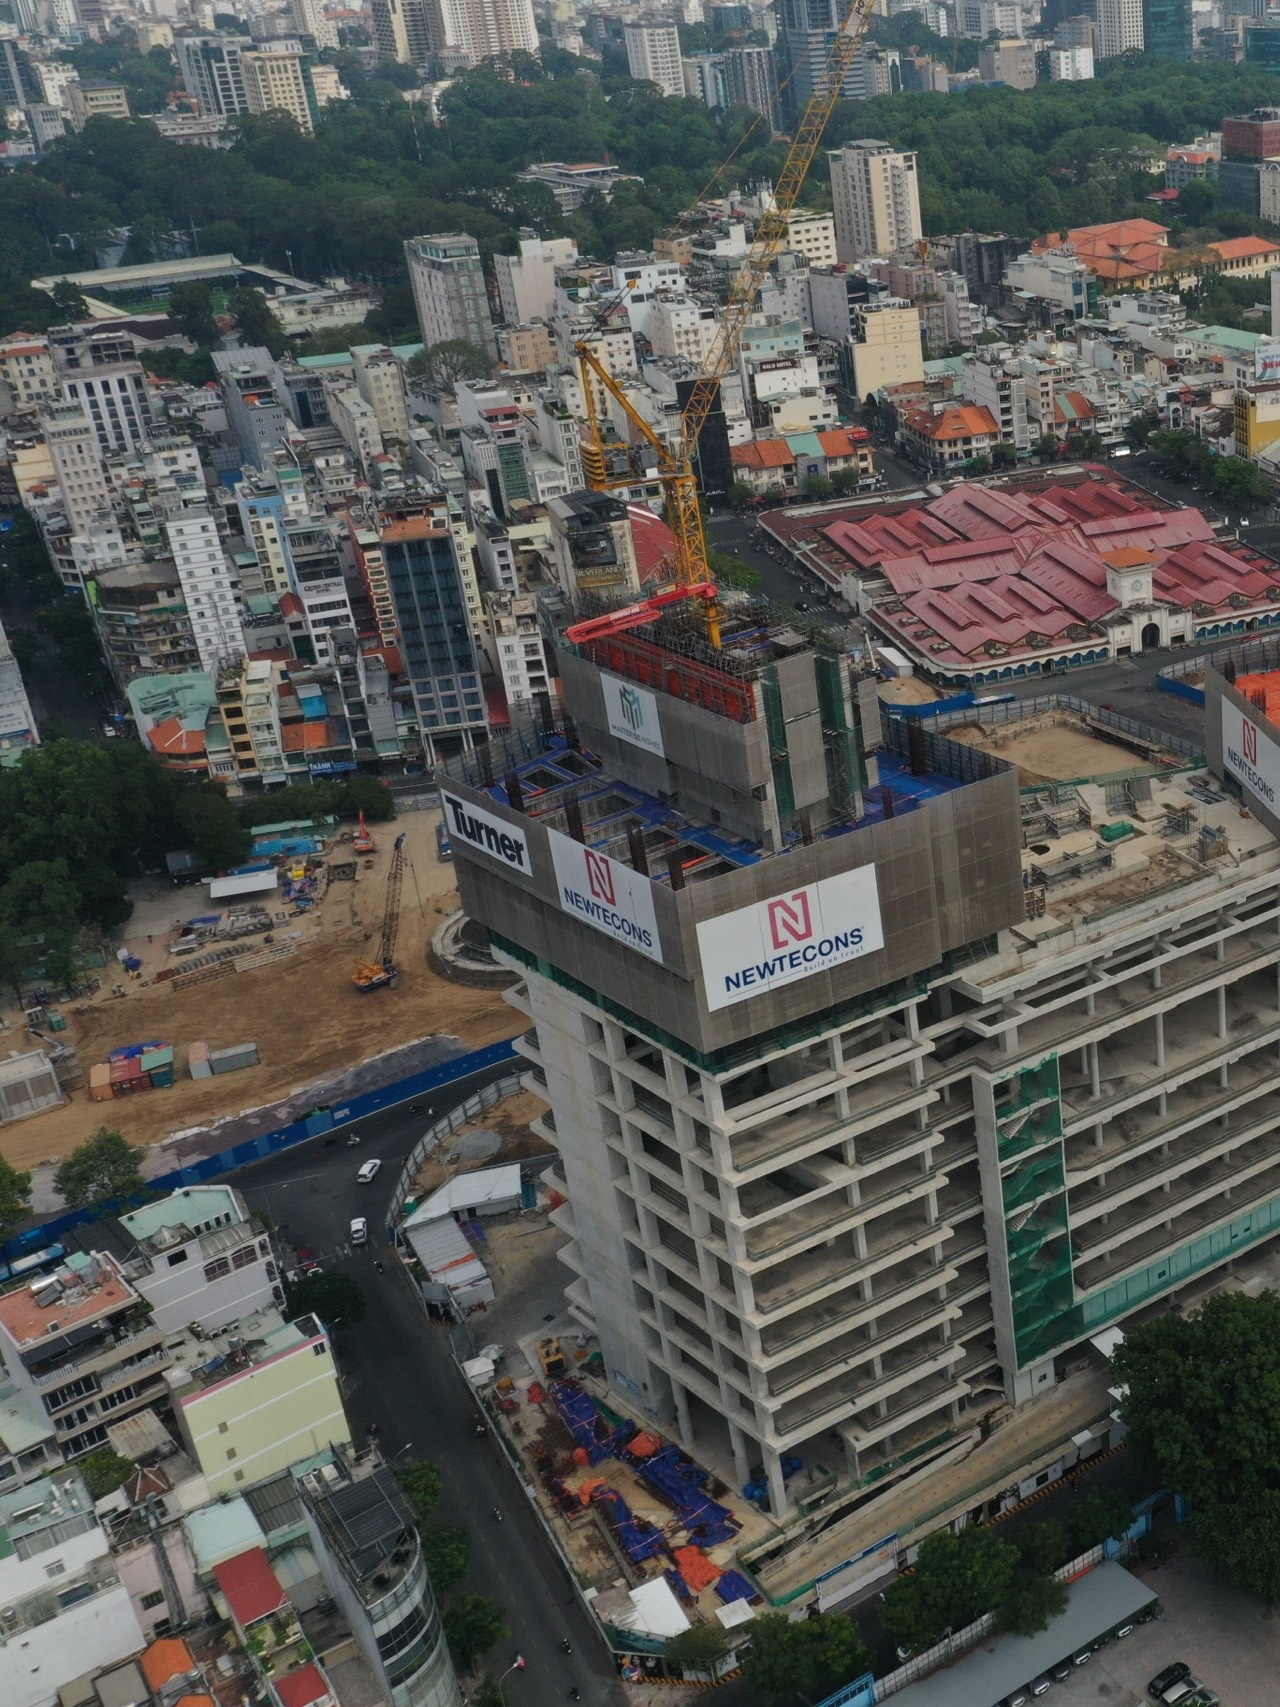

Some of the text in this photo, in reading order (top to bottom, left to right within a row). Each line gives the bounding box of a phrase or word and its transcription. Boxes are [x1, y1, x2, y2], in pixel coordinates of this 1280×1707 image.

[1227, 745, 1275, 803] NEWTECONS
[445, 795, 524, 867] Turner
[563, 886, 652, 948] NEWTECONS
[724, 927, 864, 992] NEWTECONS
